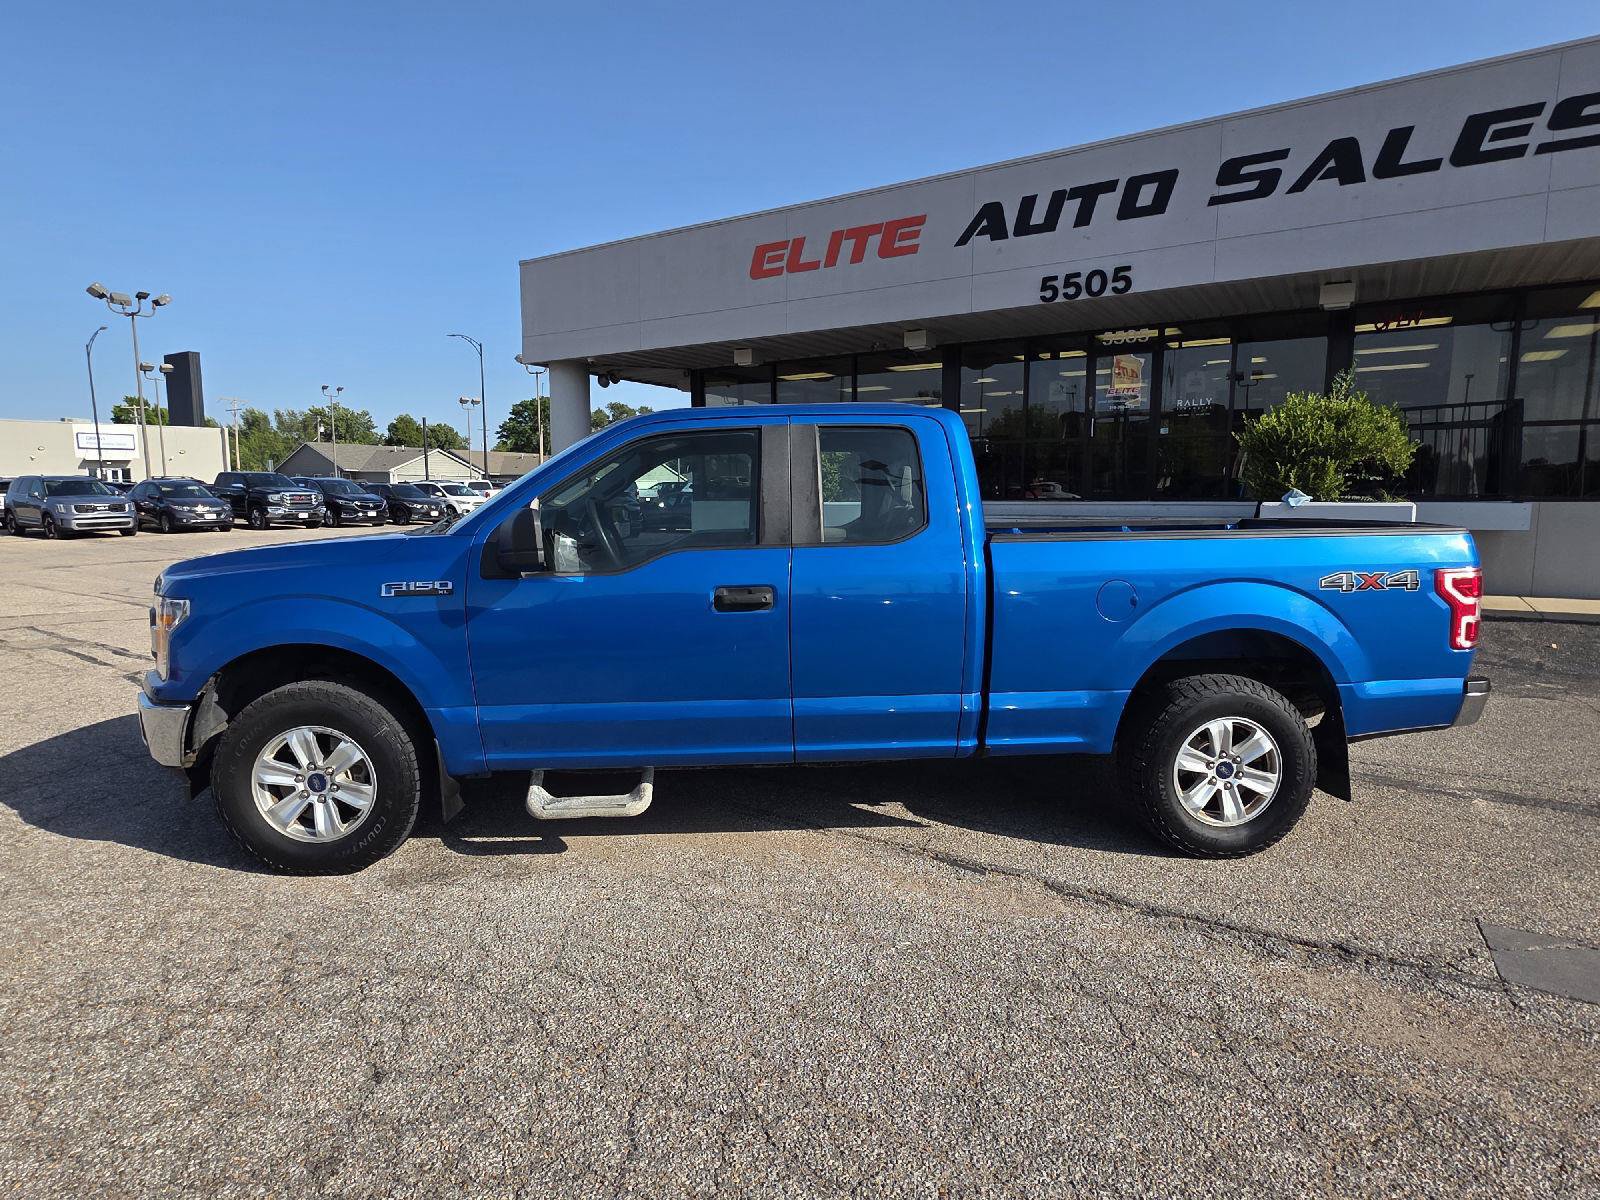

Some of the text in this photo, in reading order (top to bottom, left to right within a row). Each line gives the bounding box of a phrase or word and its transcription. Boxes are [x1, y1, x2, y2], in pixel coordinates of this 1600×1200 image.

[750, 91, 1600, 279] ELITE AUTO SALES
[1040, 265, 1133, 305] 5505
[1102, 328, 1150, 346] 5505
[1176, 397, 1213, 407] RALLY
